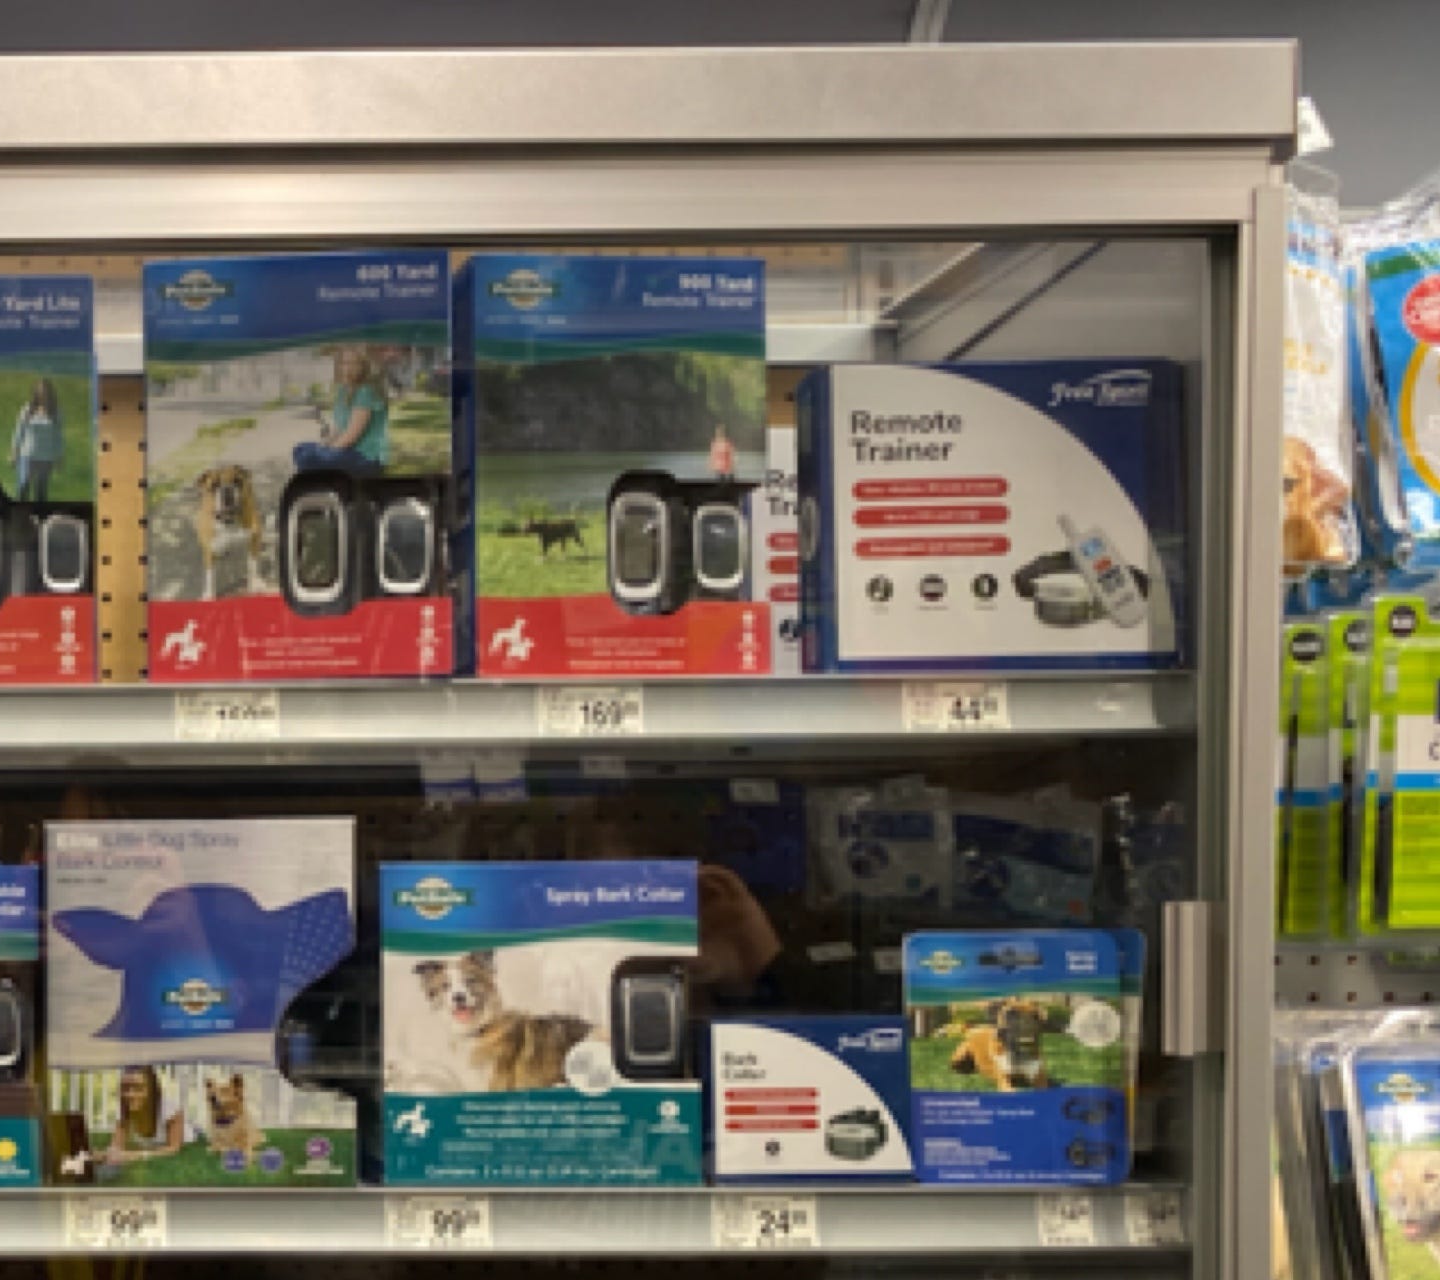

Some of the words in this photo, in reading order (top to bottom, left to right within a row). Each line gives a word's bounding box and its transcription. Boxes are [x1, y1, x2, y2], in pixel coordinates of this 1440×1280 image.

[851, 410, 962, 435] Remote
[852, 437, 954, 462] Trainer
[546, 886, 590, 907] Spray
[595, 886, 631, 902] Bark
